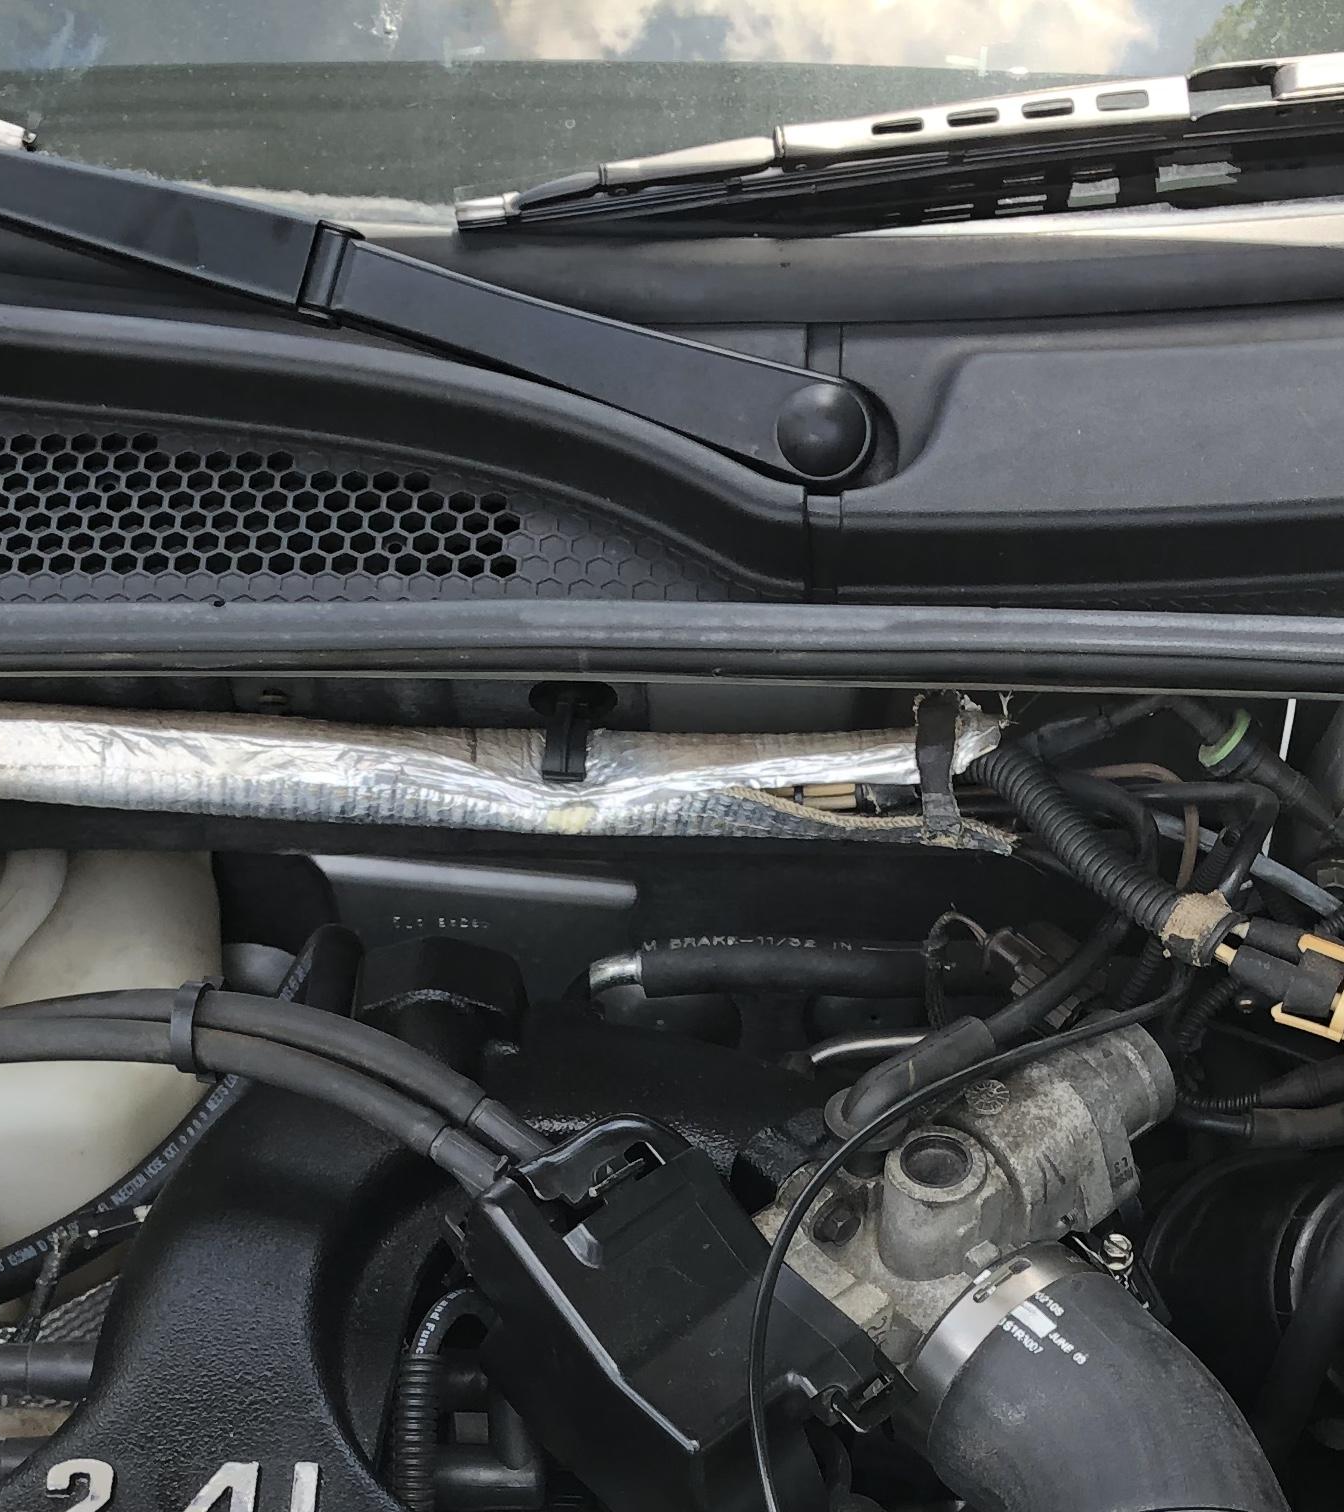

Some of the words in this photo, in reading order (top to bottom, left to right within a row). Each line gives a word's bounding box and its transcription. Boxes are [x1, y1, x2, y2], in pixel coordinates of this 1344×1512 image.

[110, 1173, 147, 1205] INJECTION
[429, 1300, 449, 1321] and
[1048, 1332, 1075, 1354] JUNE
